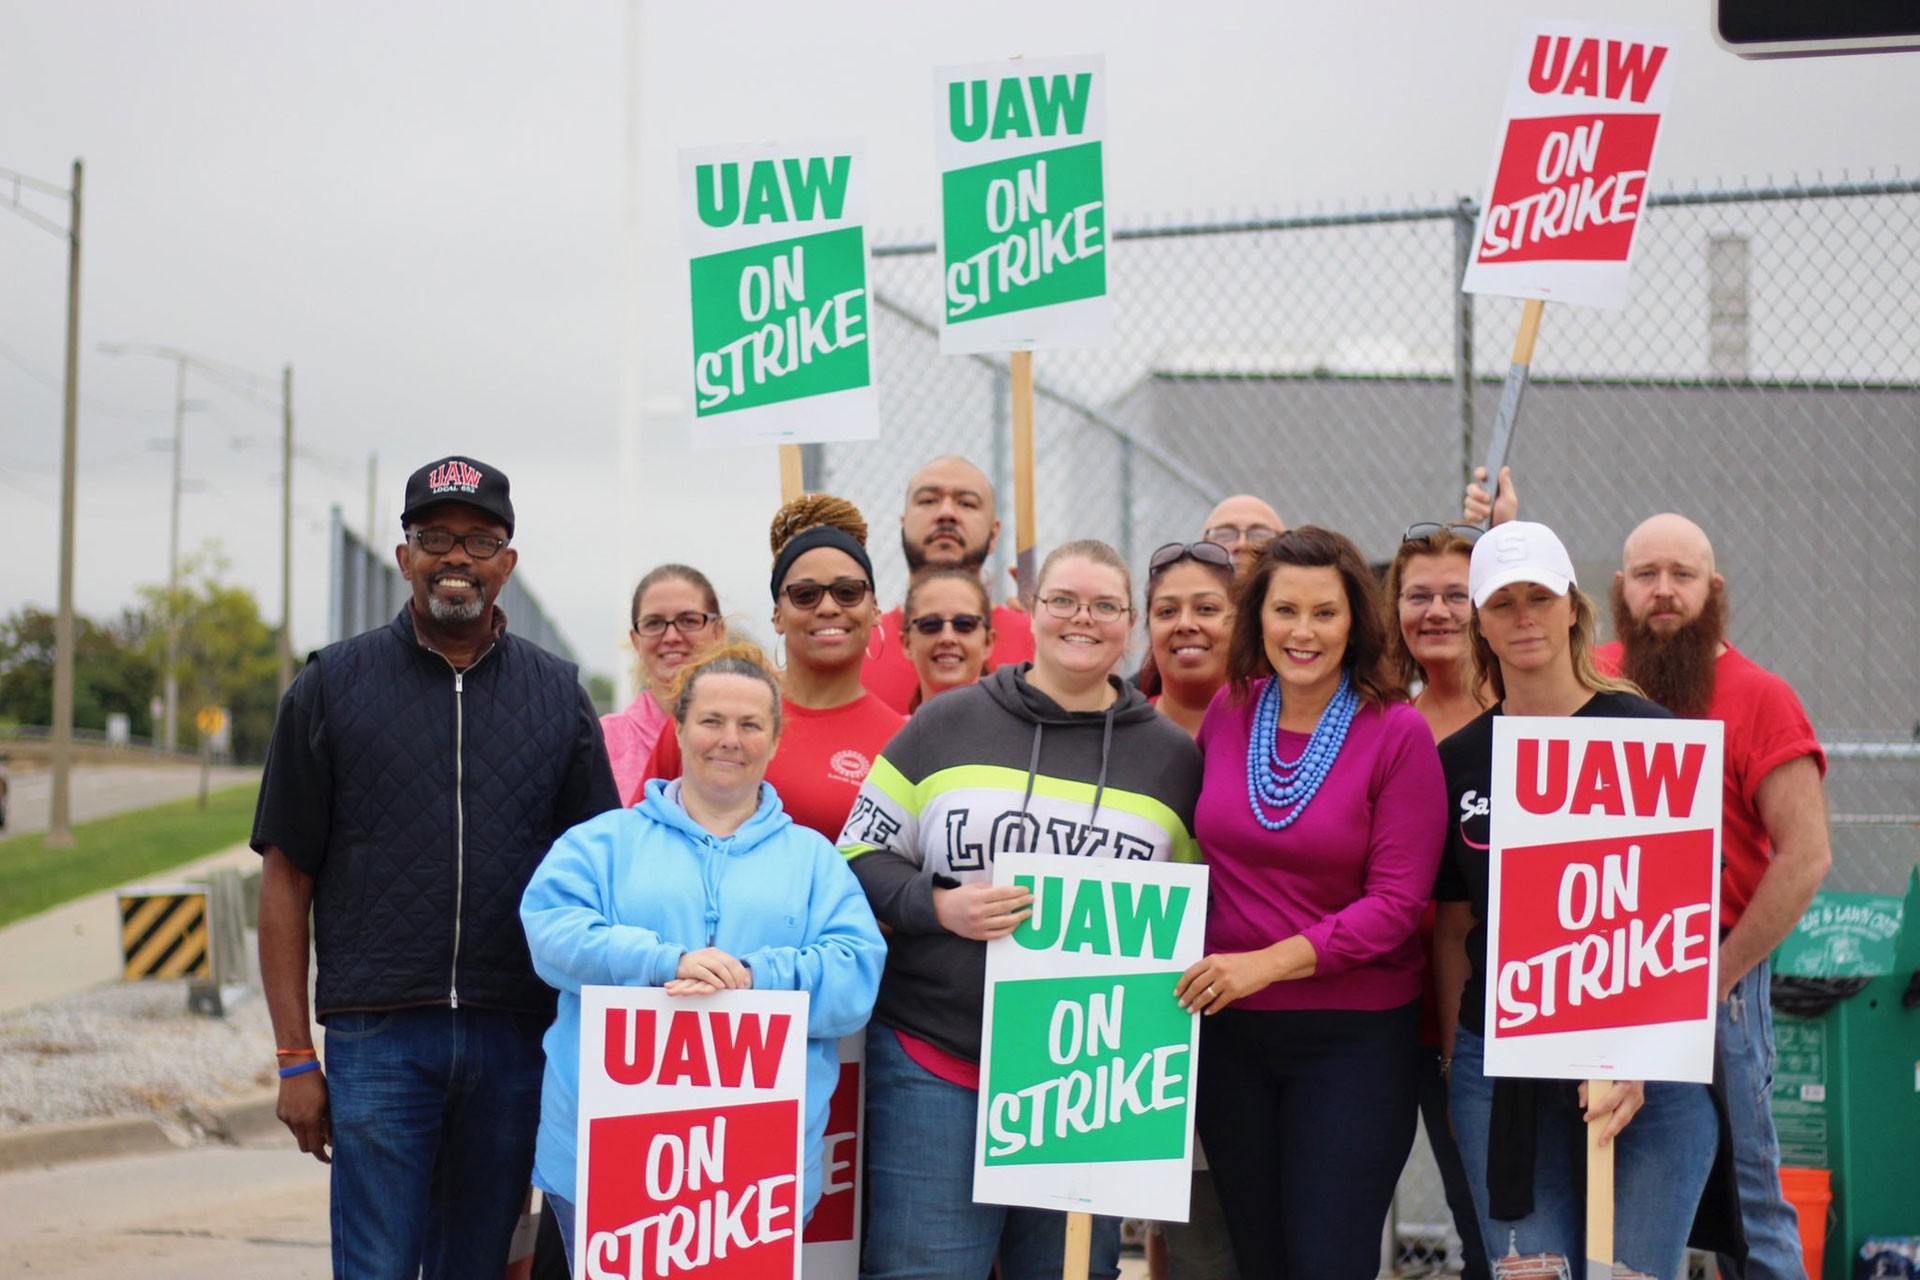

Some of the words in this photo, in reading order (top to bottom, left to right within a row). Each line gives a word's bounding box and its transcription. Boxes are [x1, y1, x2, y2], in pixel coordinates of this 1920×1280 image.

[948, 72, 1093, 143] UAW
[1528, 34, 1669, 104] UAW
[695, 154, 852, 229] UAW
[1537, 119, 1604, 184] ON
[986, 160, 1047, 233] ON
[1480, 170, 1648, 258] STRIKE
[739, 245, 805, 322] ON
[945, 200, 1104, 318] STRIKE
[695, 287, 867, 409] STRIKE
[429, 460, 483, 489] UAW
[433, 485, 458, 494] LOCAL
[1515, 737, 1706, 818] UAW
[1011, 874, 1191, 960] UAW
[1558, 844, 1641, 930] ON
[1497, 902, 1712, 1029] STRIKE
[604, 1007, 792, 1090] UAW
[1048, 984, 1125, 1066] ON
[988, 1043, 1189, 1158] STRIKE
[645, 1115, 727, 1201] ON
[586, 1173, 796, 1280] STRIKE
